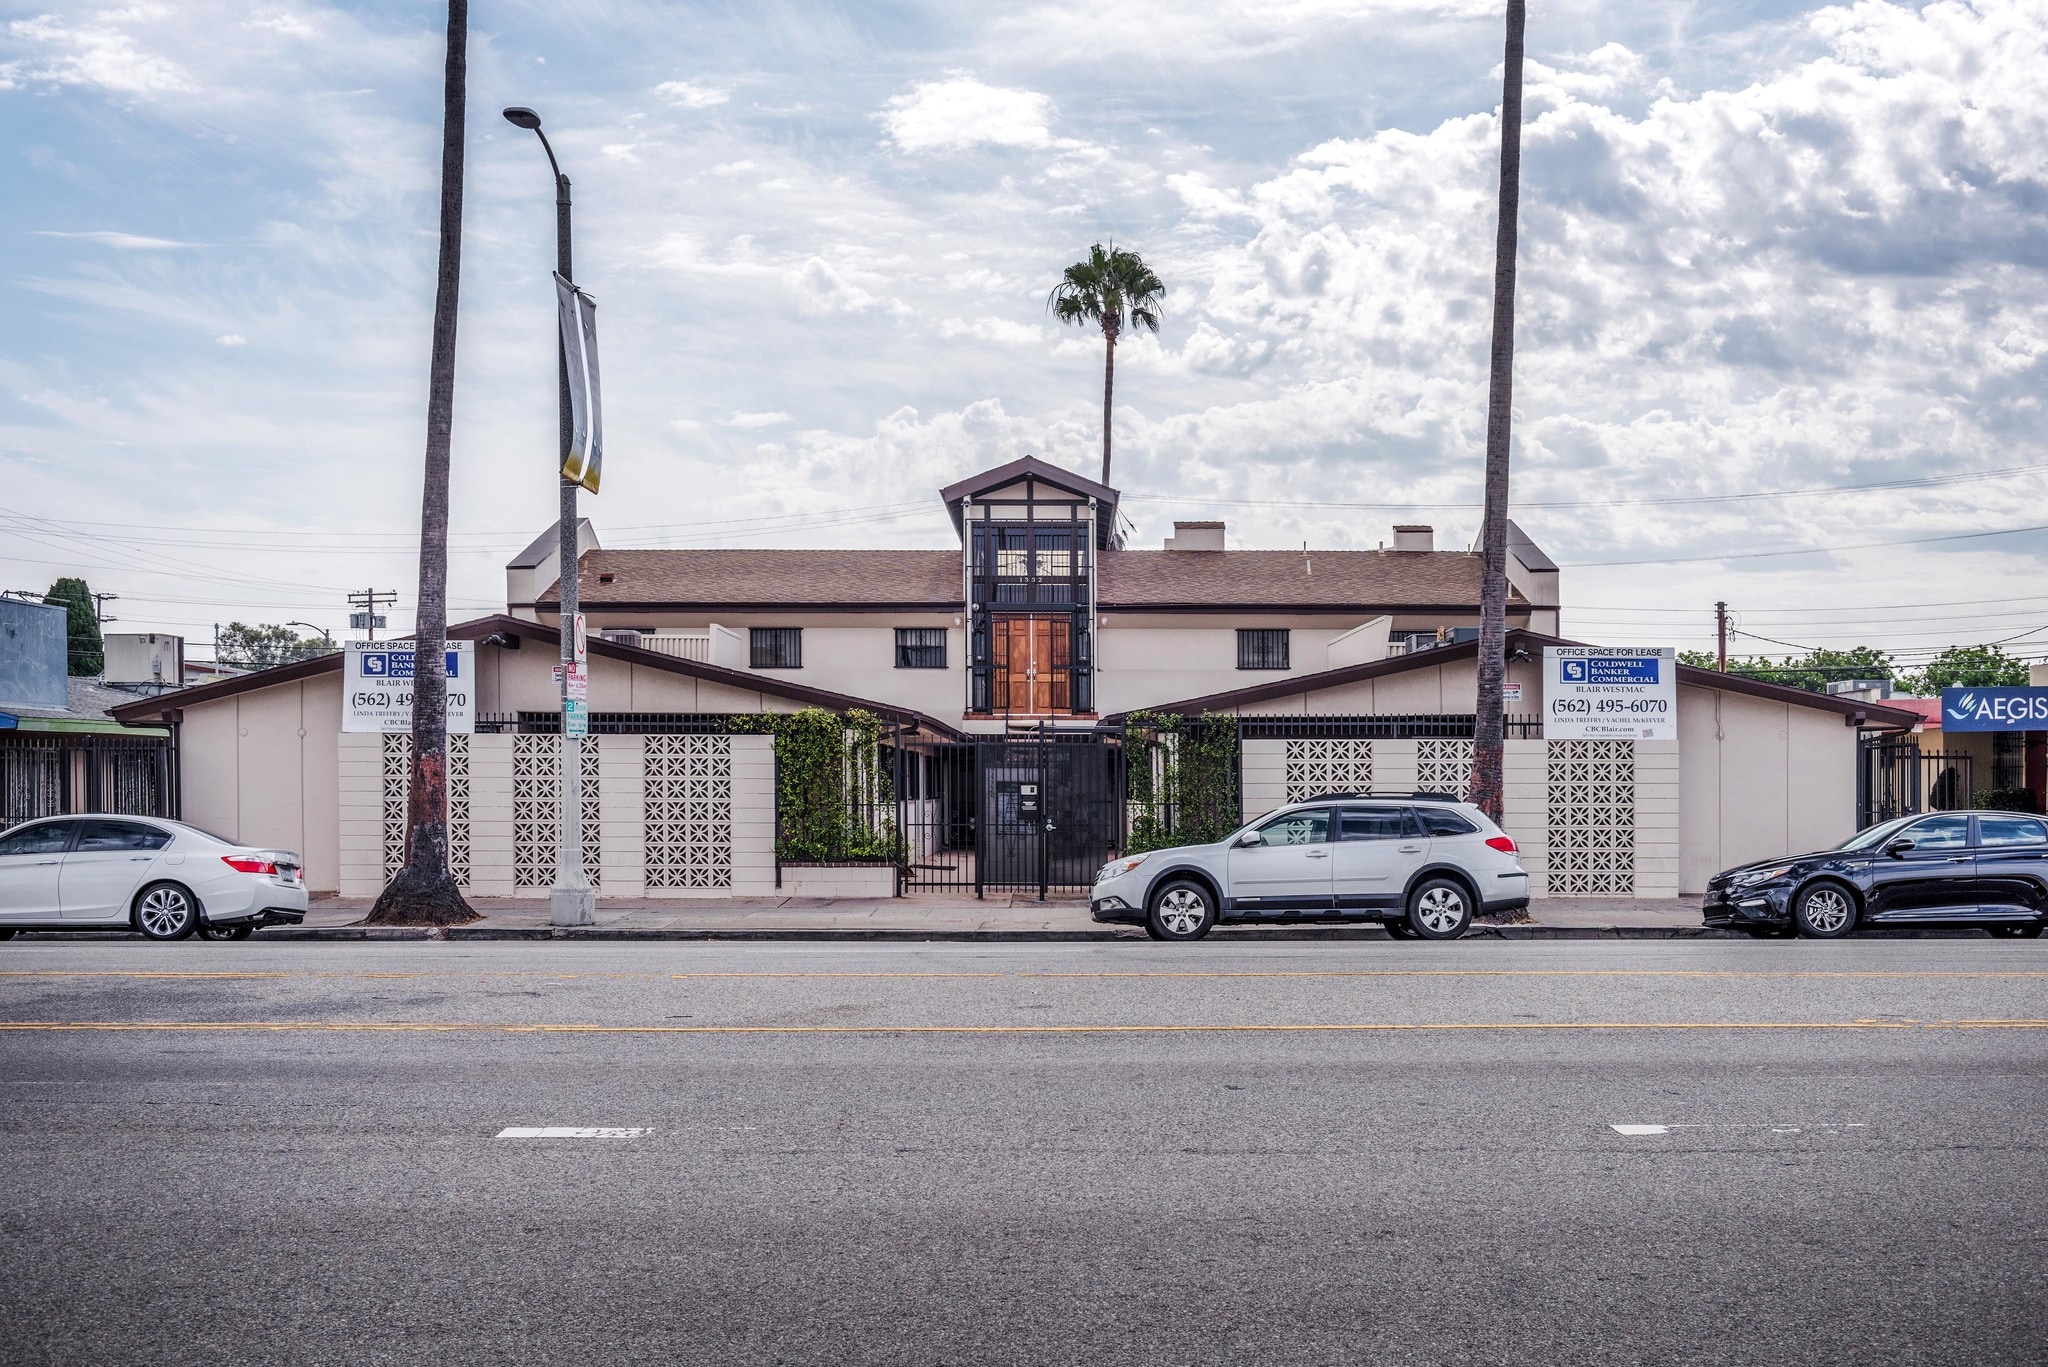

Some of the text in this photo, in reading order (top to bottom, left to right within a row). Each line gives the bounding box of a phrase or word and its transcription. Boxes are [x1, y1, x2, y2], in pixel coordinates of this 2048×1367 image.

[568, 674, 586, 682] PARKING
[352, 692, 390, 709] (562)
[568, 702, 573, 710] 2
[1552, 699, 1668, 715] (562) 495-6070
[1974, 697, 2048, 720] AEGIS
